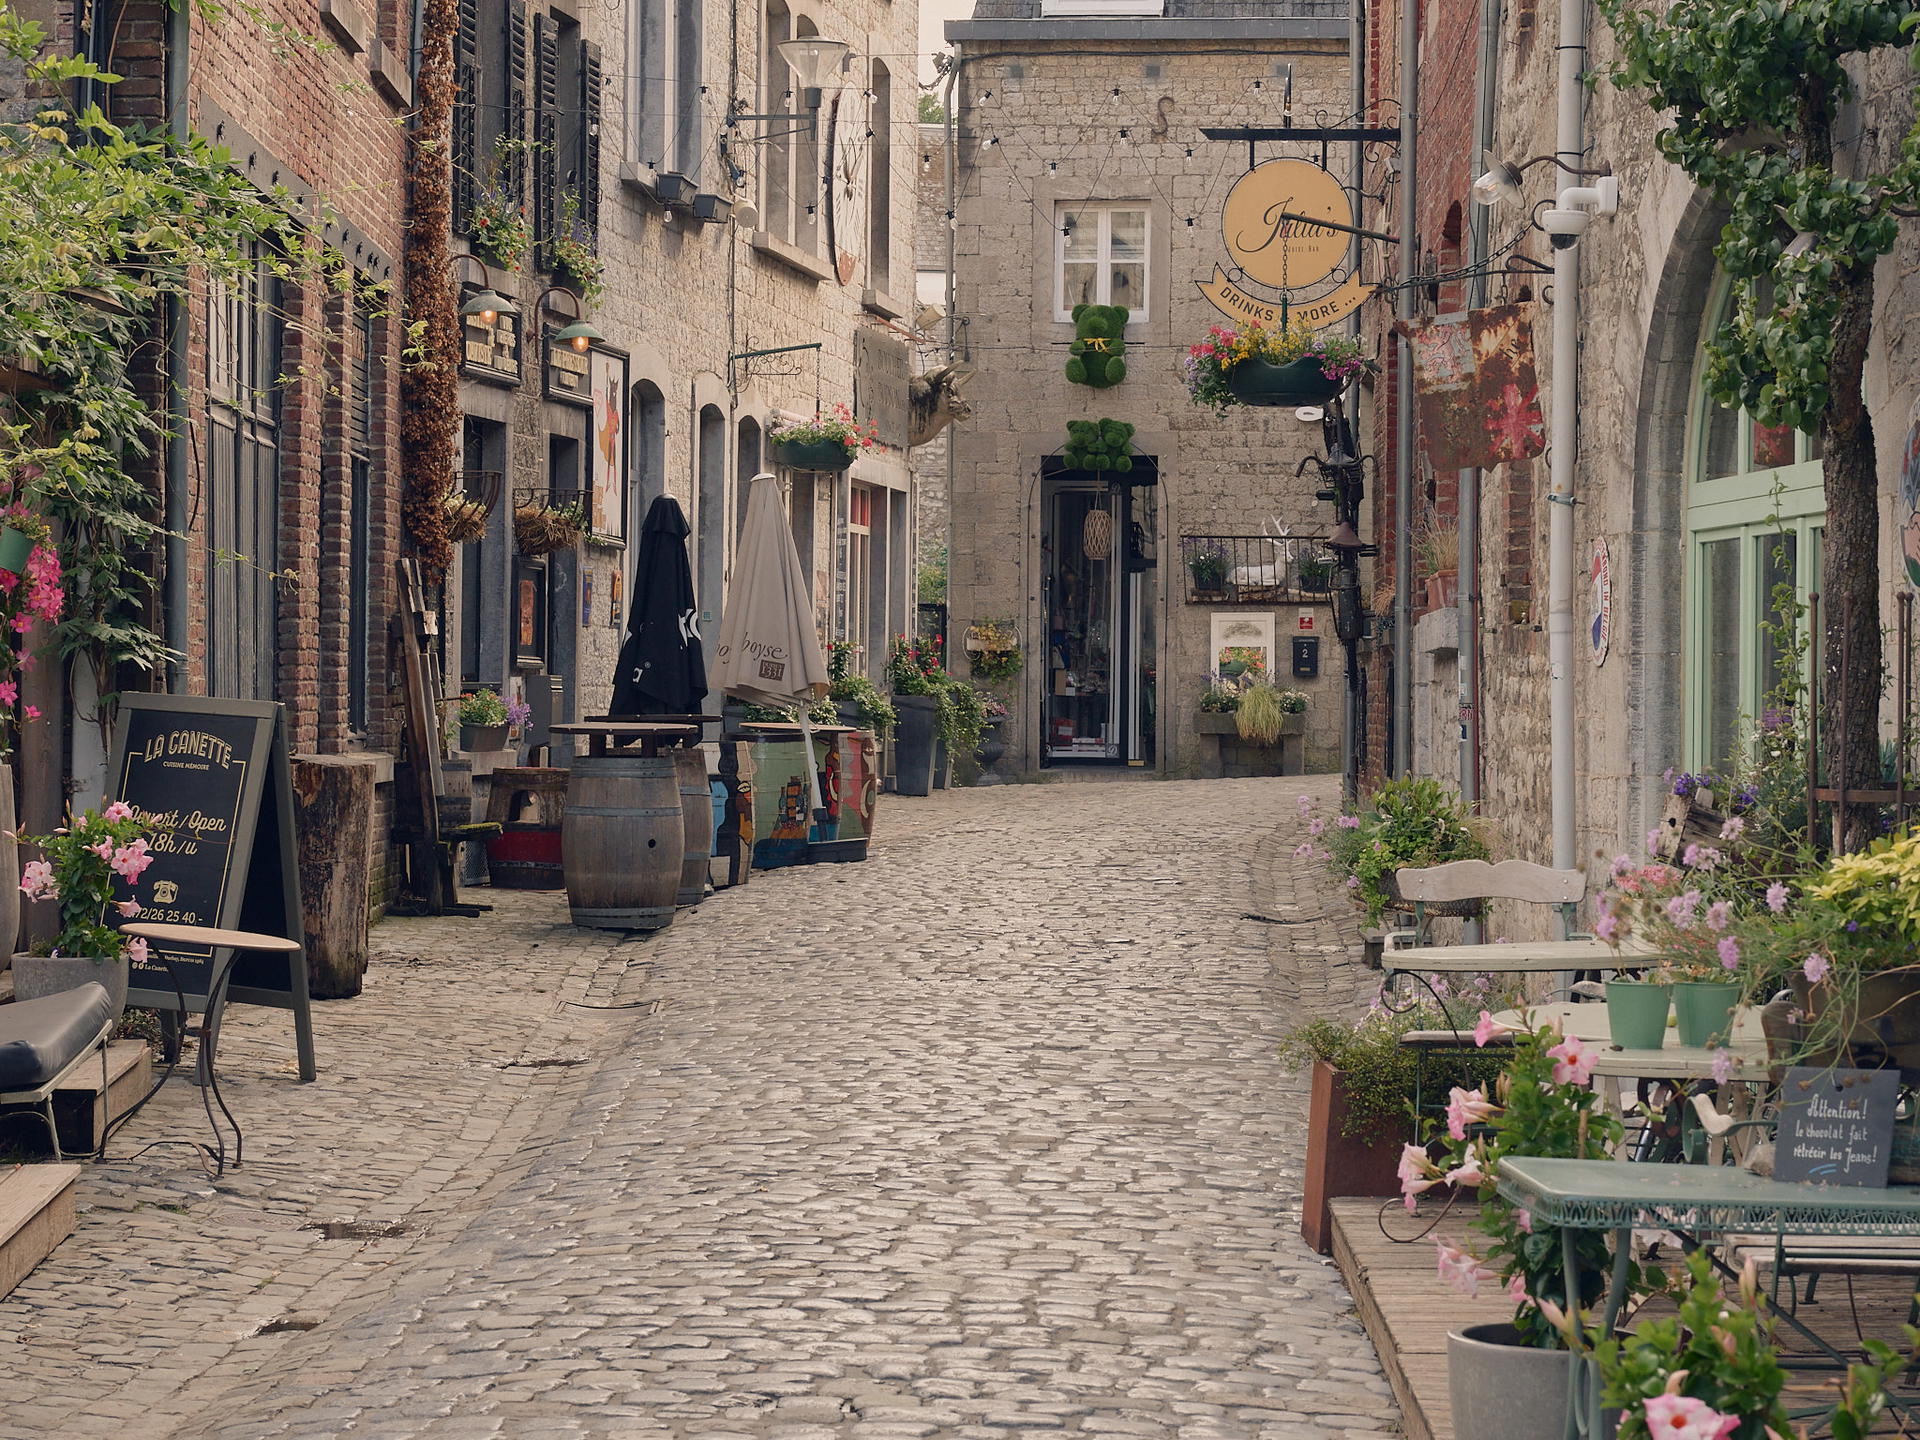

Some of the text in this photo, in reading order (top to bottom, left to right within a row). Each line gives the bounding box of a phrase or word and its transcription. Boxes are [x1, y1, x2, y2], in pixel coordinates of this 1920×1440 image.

[1236, 196, 1339, 253] Julia's
[1220, 287, 1274, 321] DRINKS
[1297, 301, 1340, 321] MORE
[1302, 648, 1309, 658] 2
[144, 729, 233, 770] LA CANETTE
[163, 760, 184, 769] CUISINE
[166, 910, 179, 922] 25
[1807, 1093, 1868, 1120] Attention!
[1806, 1122, 1843, 1140] chocolat
[1848, 1124, 1868, 1146] fait
[1830, 1146, 1842, 1160] les
